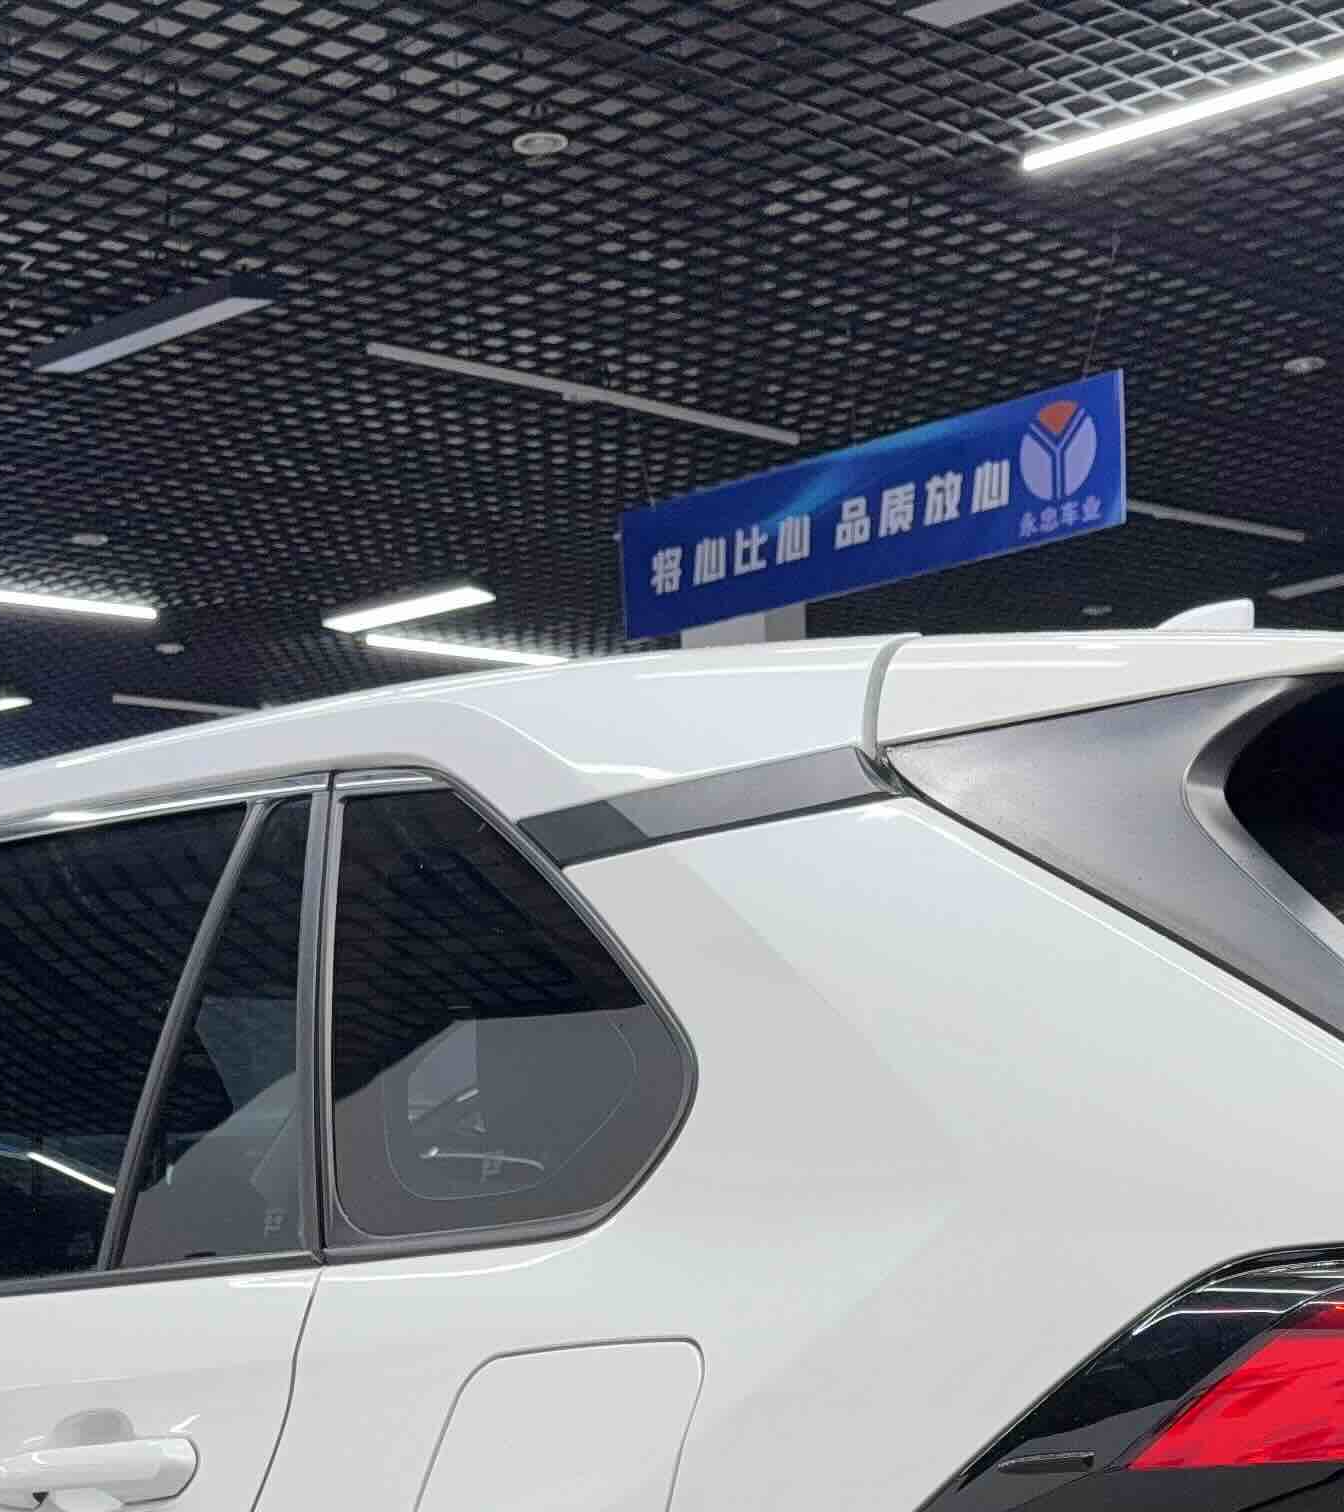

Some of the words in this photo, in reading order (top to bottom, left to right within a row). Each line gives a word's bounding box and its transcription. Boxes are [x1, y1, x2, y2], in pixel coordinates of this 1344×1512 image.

[650, 513, 810, 595] 将心比心
[834, 459, 1010, 550] 品质放心
[1019, 495, 1102, 539] 永忠车业
